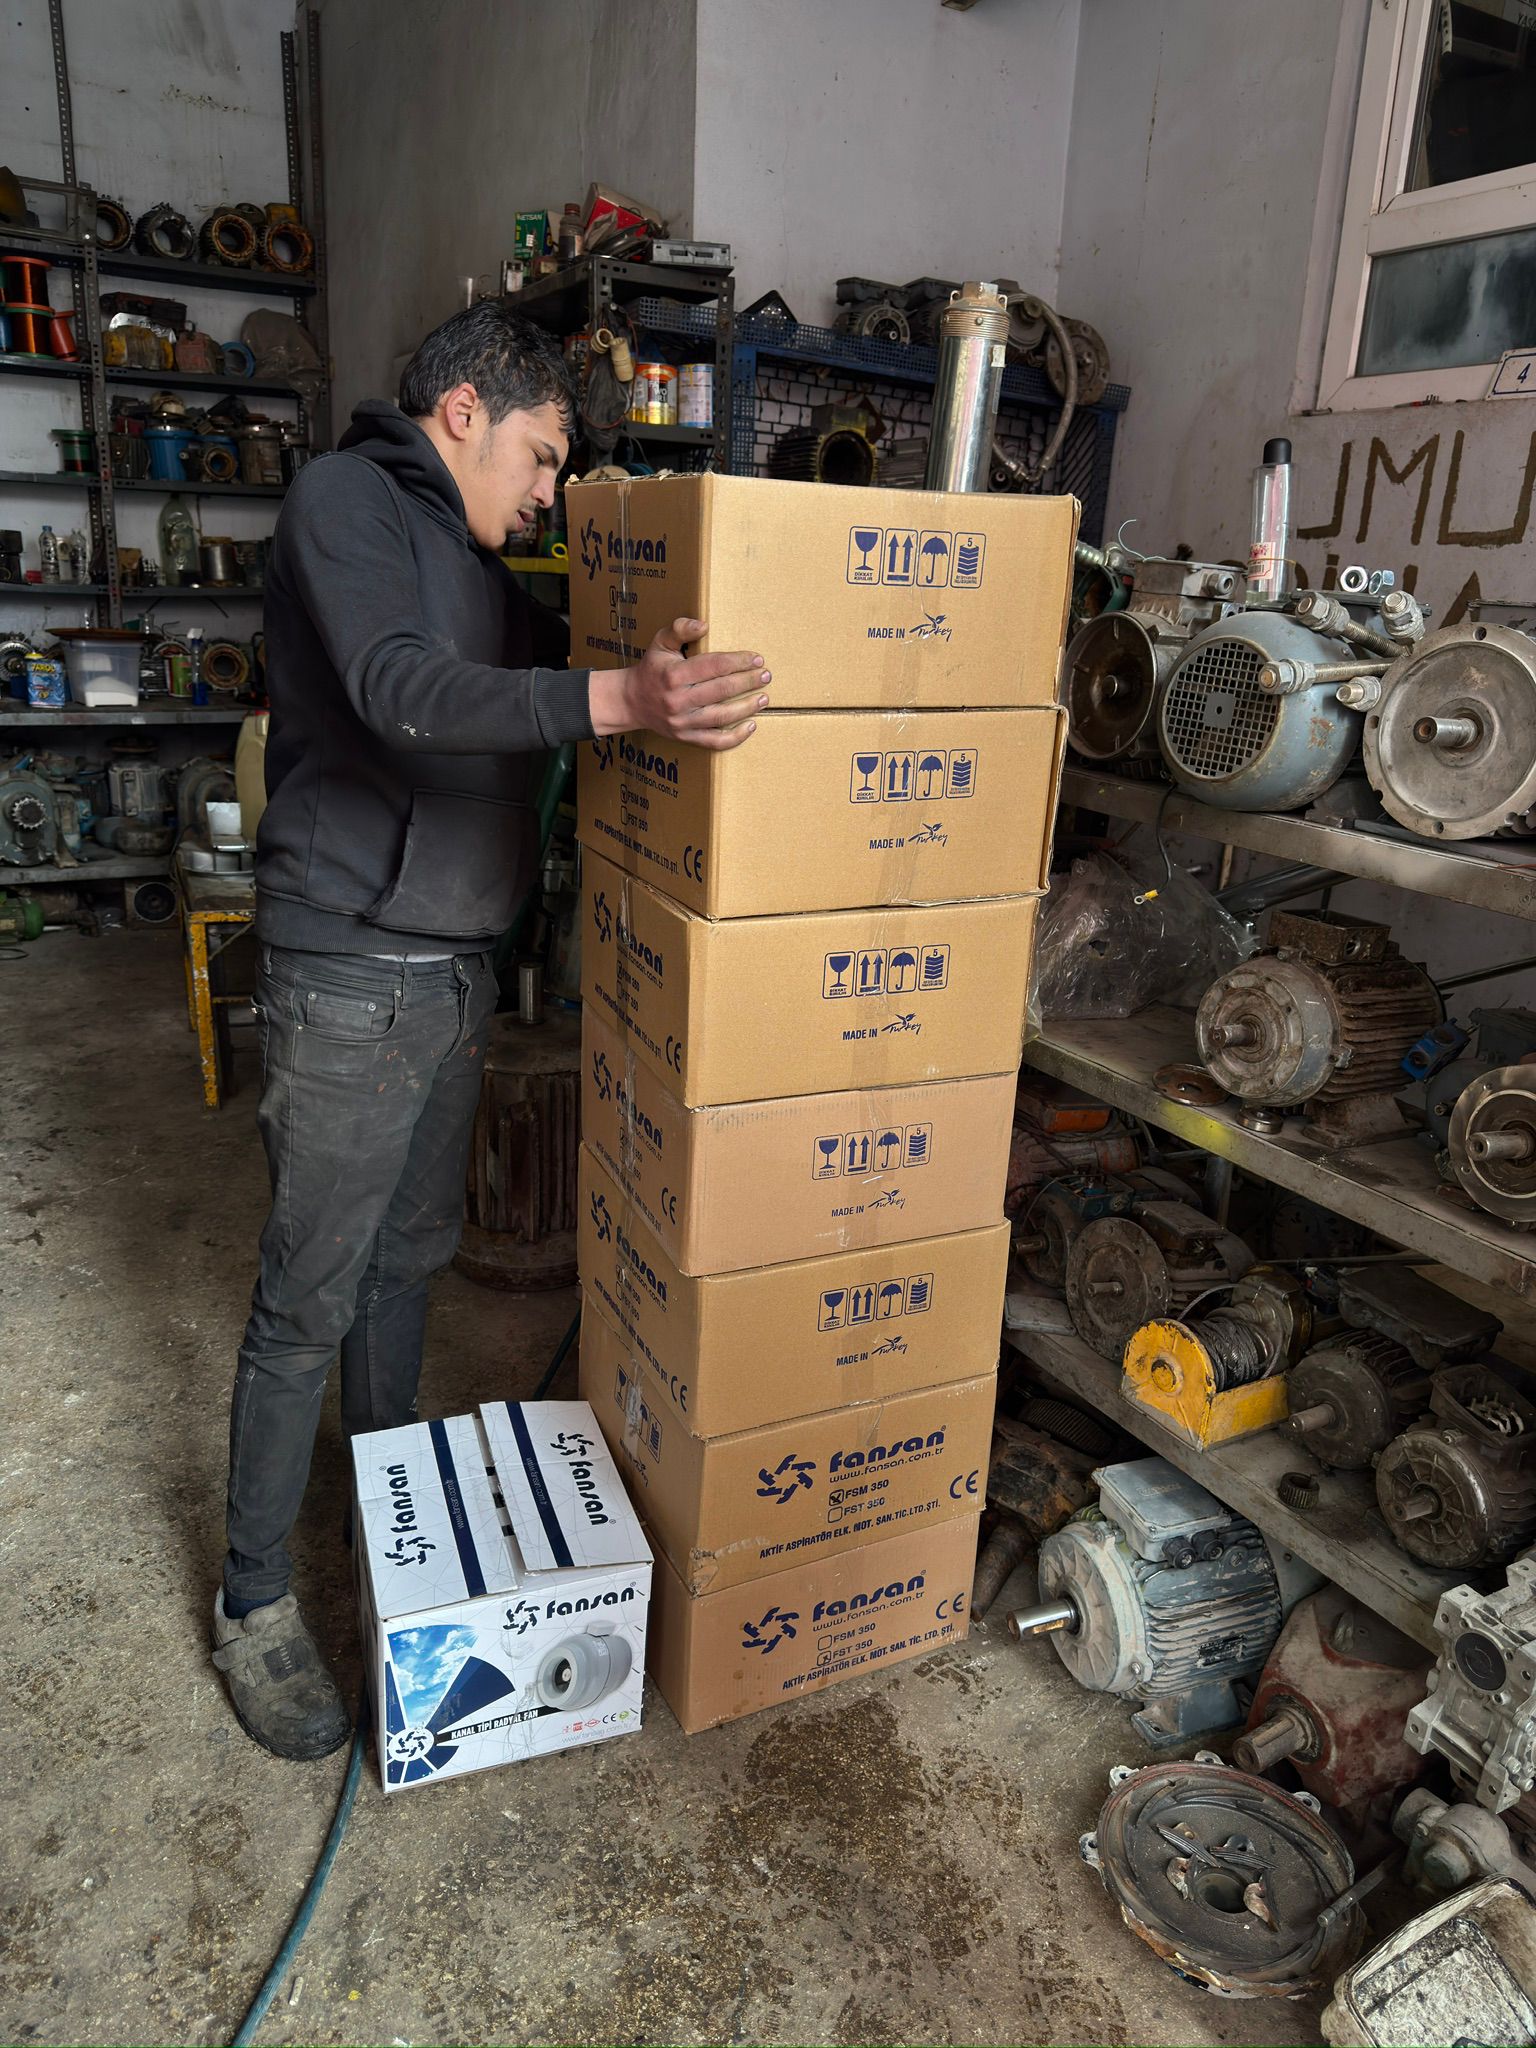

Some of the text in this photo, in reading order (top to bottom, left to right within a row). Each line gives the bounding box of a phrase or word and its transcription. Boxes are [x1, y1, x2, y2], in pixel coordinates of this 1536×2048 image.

[1517, 363, 1531, 384] 4
[607, 530, 667, 563] fansan
[967, 537, 973, 547] 5
[868, 628, 893, 639] MADE
[896, 628, 905, 639] IN
[619, 735, 679, 784] fansan
[960, 753, 966, 762] 5
[869, 839, 893, 849] MADE
[895, 838, 904, 848] IN
[843, 1029, 866, 1040] MADE
[869, 1028, 877, 1038] IN
[916, 1127, 921, 1135] 5
[831, 1206, 854, 1217] MADE
[856, 1205, 864, 1214] IN
[616, 1226, 667, 1302] fansan
[836, 1354, 858, 1366] MADE
[860, 1352, 868, 1361] IN
[829, 1430, 945, 1473] fansan
[829, 1447, 944, 1483] www.fansan.com.tr
[569, 1461, 609, 1525] fansan
[844, 1479, 889, 1500] FSM 350
[949, 1470, 979, 1499] CE
[387, 1464, 418, 1533] fansan
[843, 1497, 885, 1517] FST 350
[546, 1587, 635, 1619] fansan
[813, 1575, 925, 1622] fansan
[935, 1592, 965, 1620] CE
[812, 1590, 925, 1632] www.fansan.com.tr
[833, 1623, 876, 1643] FSM 350
[782, 1674, 806, 1690] AKTİF
[806, 1659, 850, 1681] ASPİRATÖR
[851, 1656, 868, 1670] ELK.
[869, 1648, 888, 1661] MOT.
[890, 1642, 907, 1654] SAN.
[924, 1629, 940, 1641] LTD.
[941, 1623, 955, 1638] ŞTİ.
[832, 1639, 872, 1660] FST 350
[451, 1709, 539, 1740] KANAL TİPİ RADYAL FAN
[602, 1713, 617, 1724] CE
